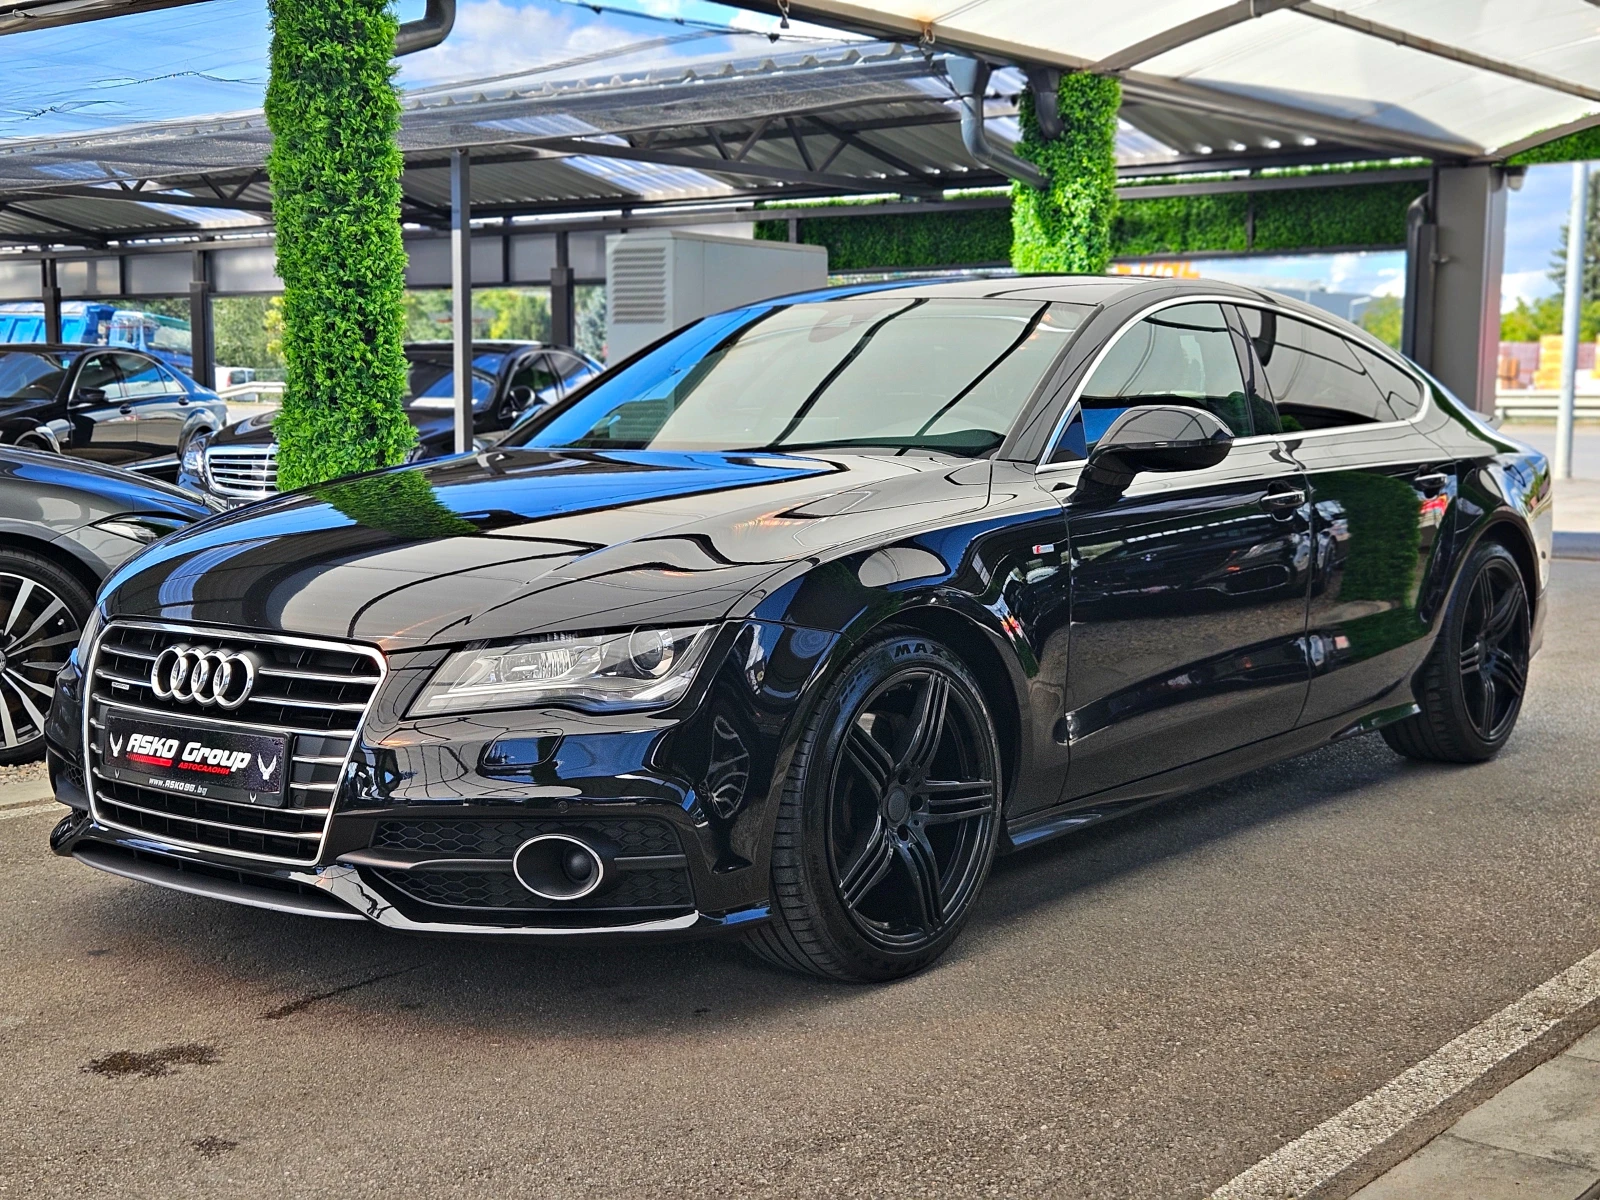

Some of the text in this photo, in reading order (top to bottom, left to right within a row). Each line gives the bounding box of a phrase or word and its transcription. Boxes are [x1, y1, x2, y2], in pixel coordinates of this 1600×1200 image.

[126, 733, 251, 771] ASKO Group
[178, 762, 230, 775] АВТОСАЛОНИ
